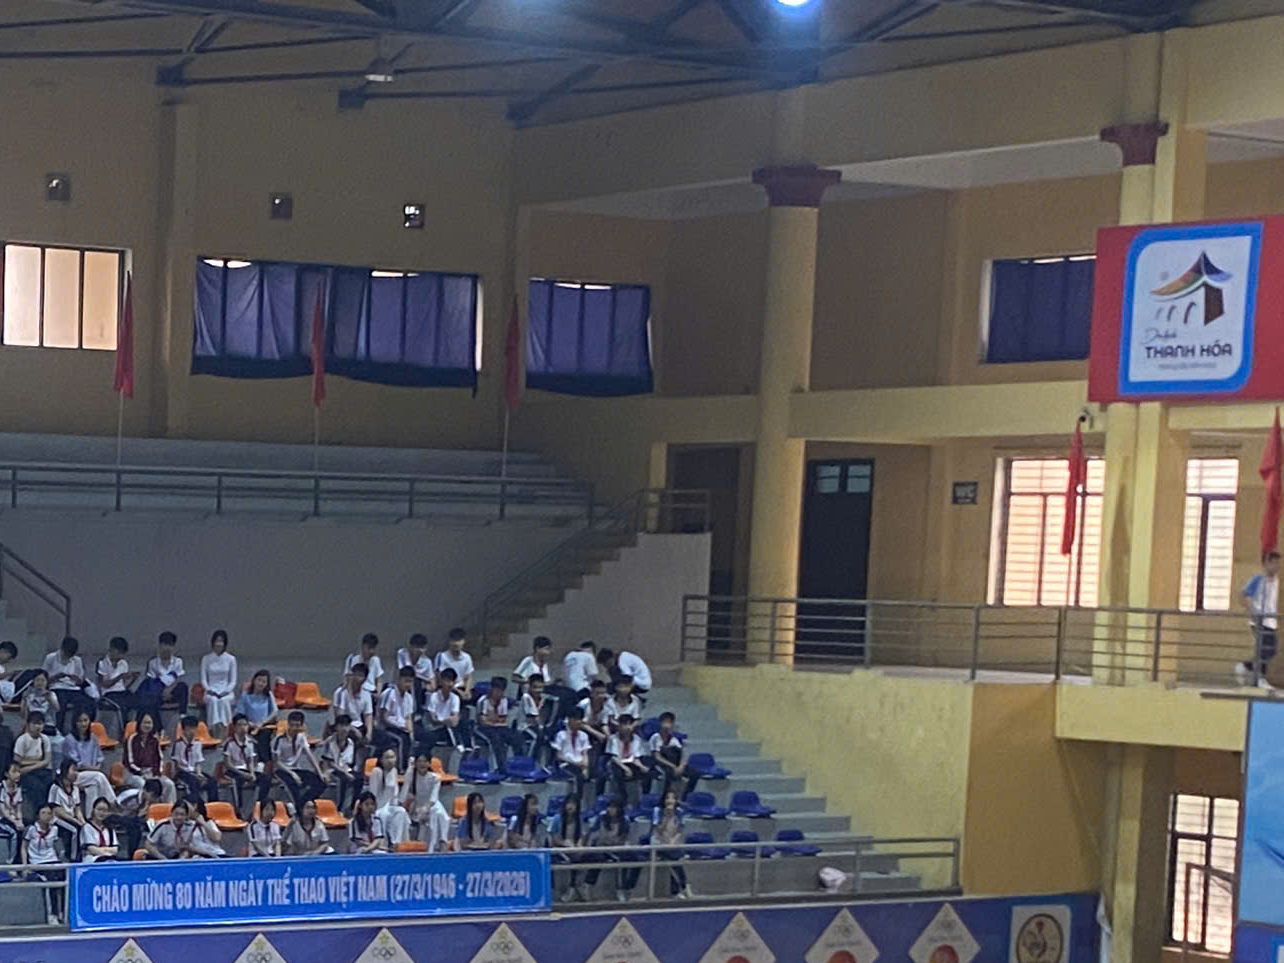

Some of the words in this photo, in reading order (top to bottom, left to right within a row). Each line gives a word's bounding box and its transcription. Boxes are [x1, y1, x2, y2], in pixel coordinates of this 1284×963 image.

[1145, 345, 1196, 359] THANH
[1200, 339, 1232, 357] HÓA
[92, 878, 129, 912] CHÀO
[132, 877, 173, 911] MỪNG
[175, 882, 192, 909] 80
[195, 875, 226, 909] NĂM
[228, 873, 265, 907] NGÀY
[266, 866, 291, 906] THỂ
[293, 876, 326, 904] THAO
[328, 870, 356, 908] VIỆT
[357, 874, 388, 902] NAM
